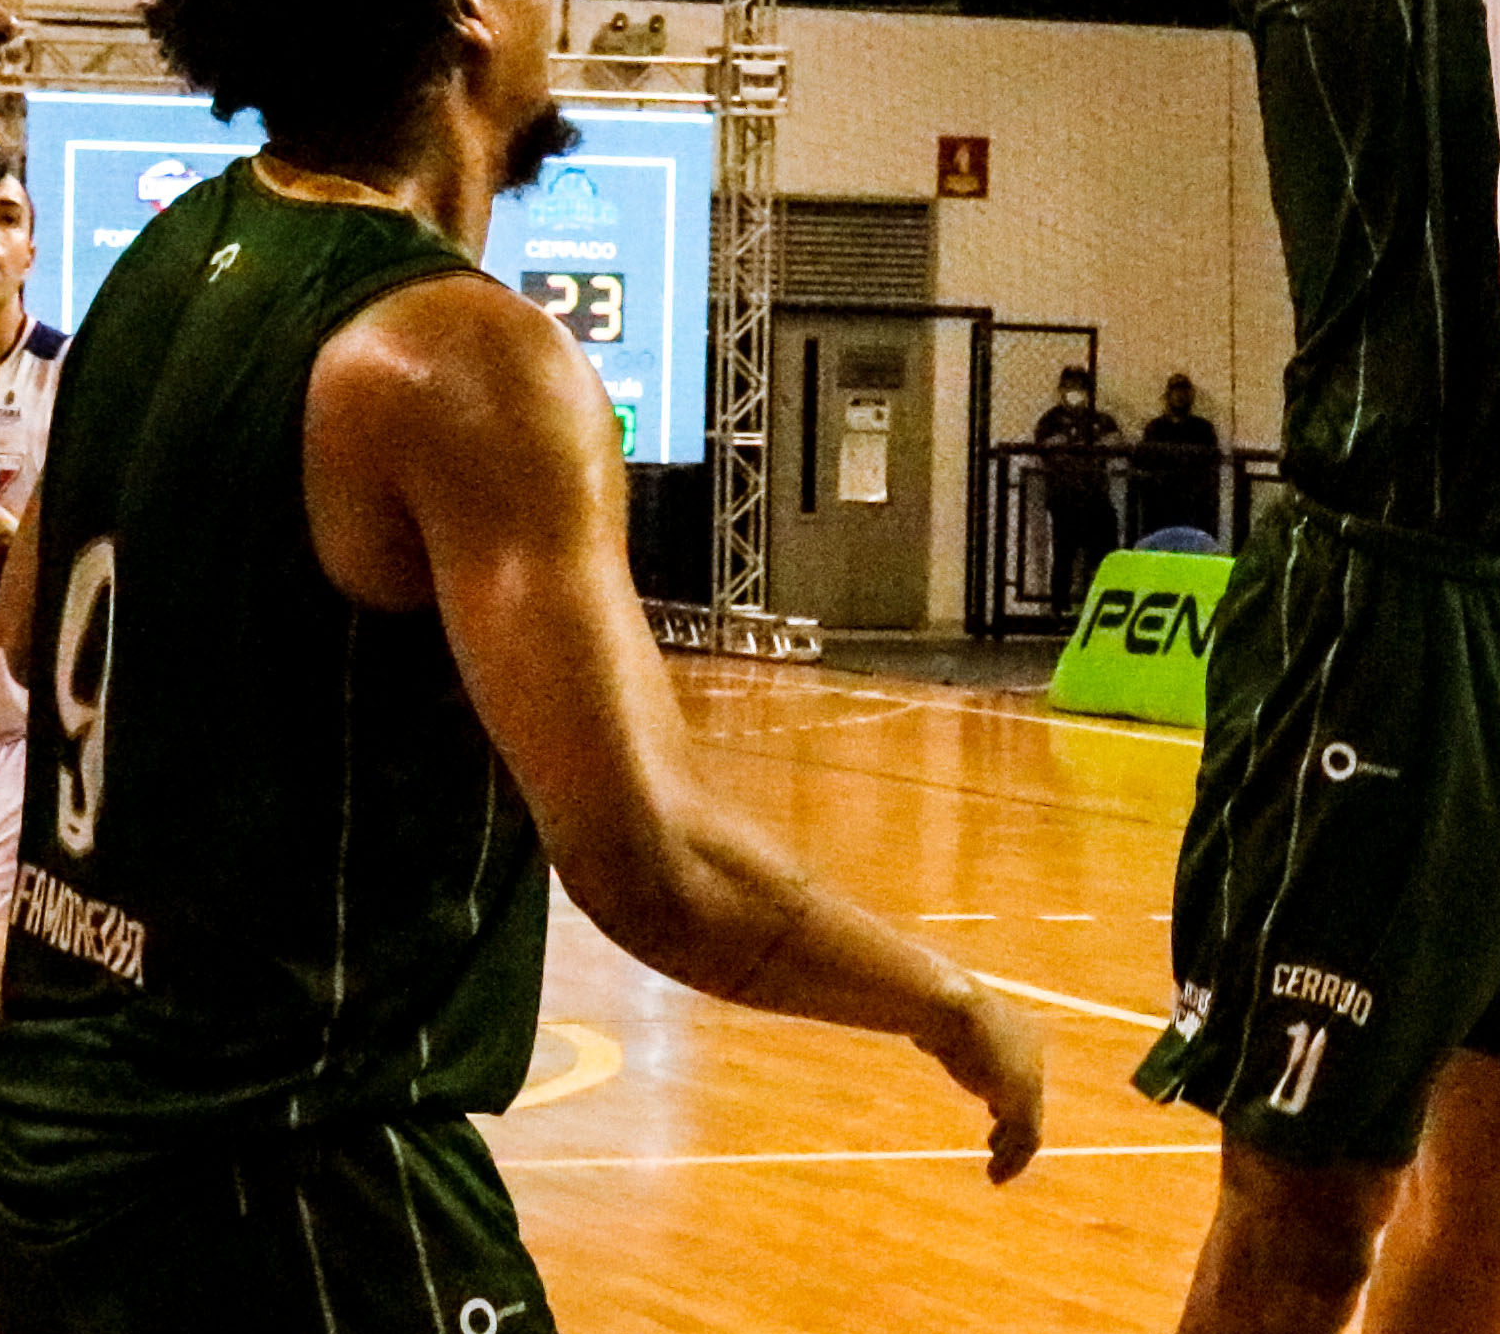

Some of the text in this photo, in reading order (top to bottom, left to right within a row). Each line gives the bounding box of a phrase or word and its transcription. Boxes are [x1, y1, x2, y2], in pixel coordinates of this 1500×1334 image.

[525, 240, 617, 260] CERRADO
[544, 274, 622, 342] 23
[56, 538, 114, 857] 9
